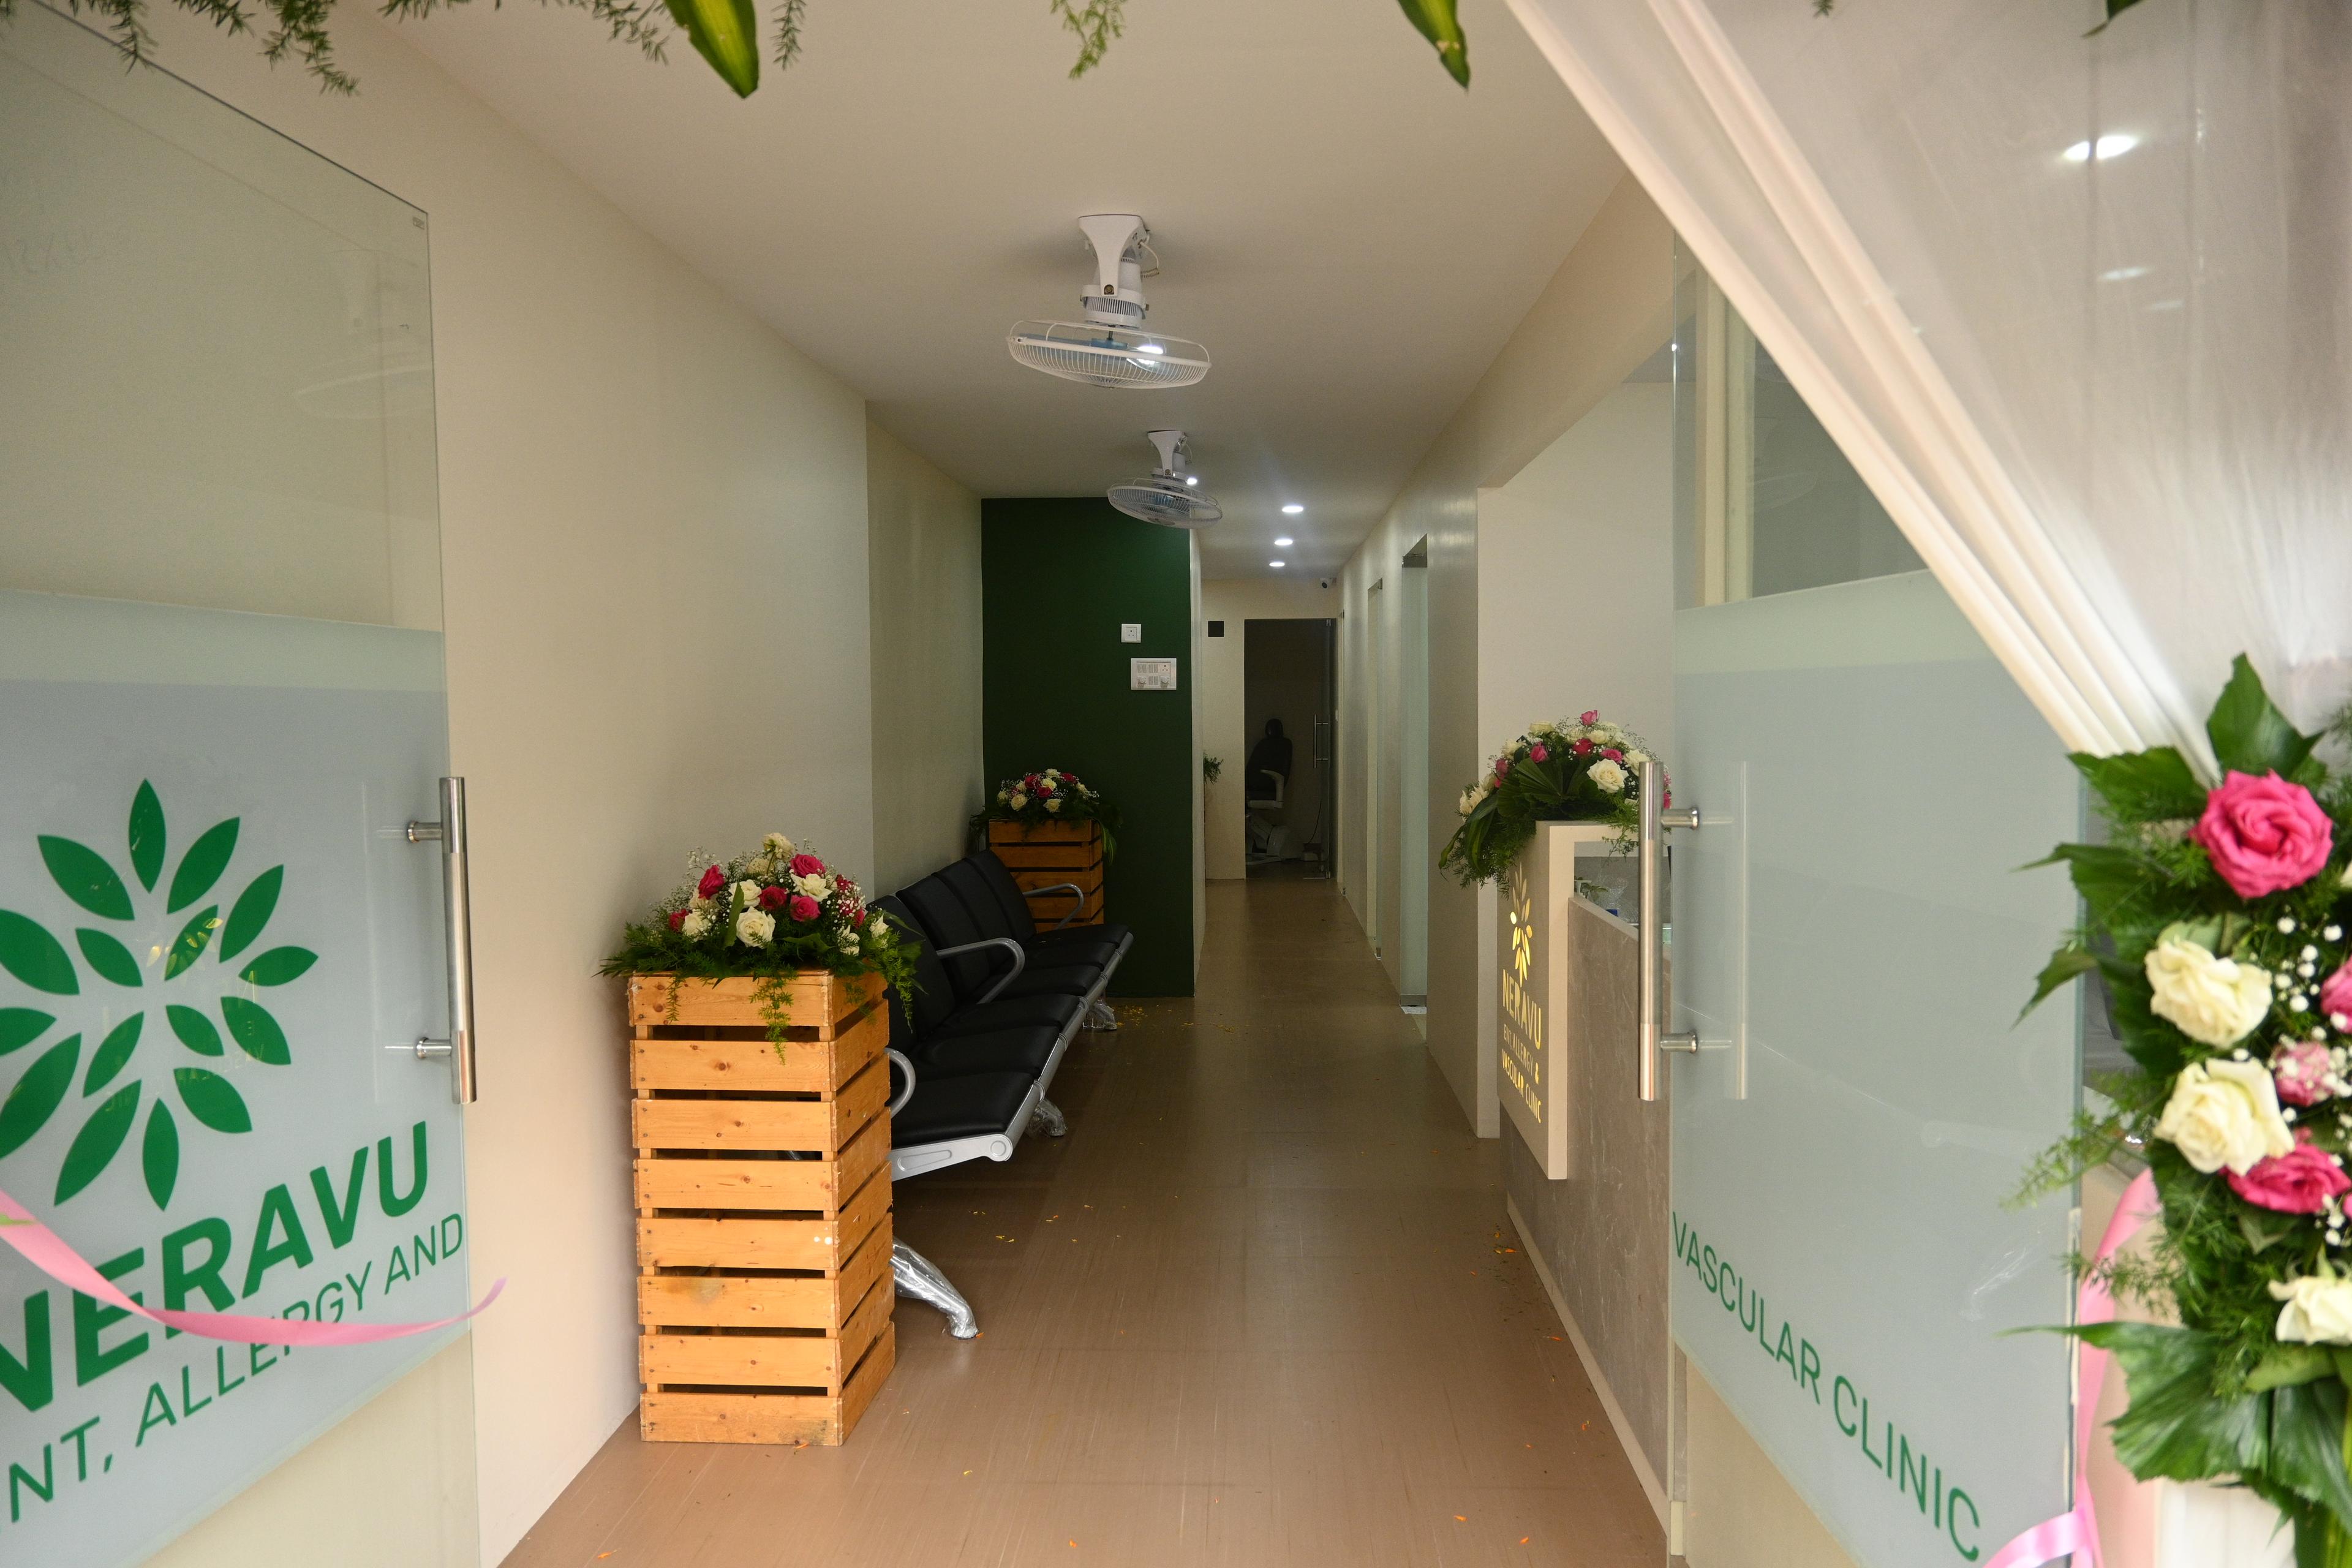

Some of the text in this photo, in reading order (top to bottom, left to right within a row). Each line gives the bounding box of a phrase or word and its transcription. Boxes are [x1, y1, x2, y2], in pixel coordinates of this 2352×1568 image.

[1502, 969, 1542, 1050] NERAVU
[1502, 1048, 1541, 1123] VASCULAR CLINIC
[1512, 1033, 1534, 1076] ALLERGY
[1534, 1063, 1539, 1085] &
[0, 1415, 113, 1533] NT,
[384, 1213, 463, 1295] AND
[1673, 1211, 1980, 1561] VASCULAR CLINIC
